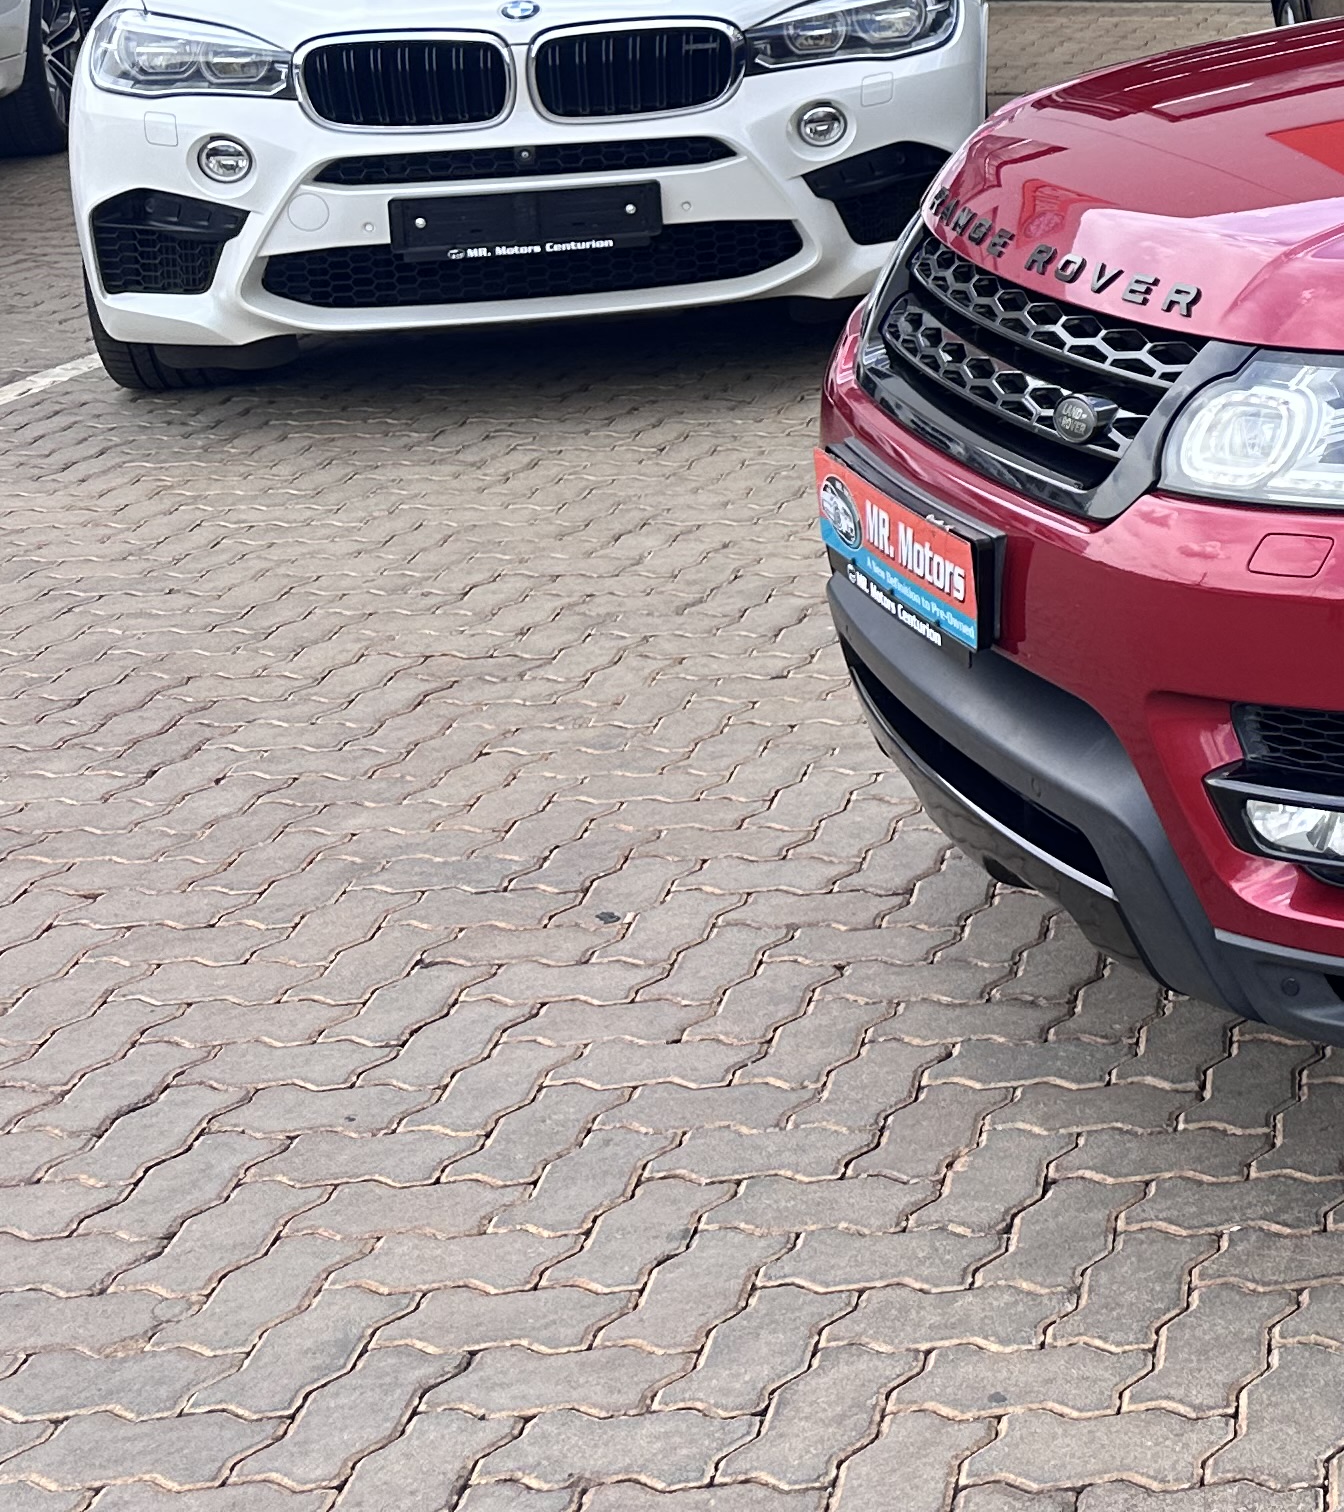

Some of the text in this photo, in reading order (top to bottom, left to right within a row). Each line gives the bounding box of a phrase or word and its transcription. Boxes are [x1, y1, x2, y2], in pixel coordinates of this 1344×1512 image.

[466, 238, 614, 259] MR. Motors Centurion
[929, 185, 1204, 317] RANGE ROVER
[1060, 416, 1087, 435] ROVER
[1062, 403, 1084, 420] LAND
[865, 499, 966, 602] MR. Motors
[870, 583, 896, 614] Motors
[897, 603, 942, 647] Centurion
[886, 571, 921, 606] Definition
[921, 596, 931, 611] to
[931, 601, 975, 640] Pre-Owned
